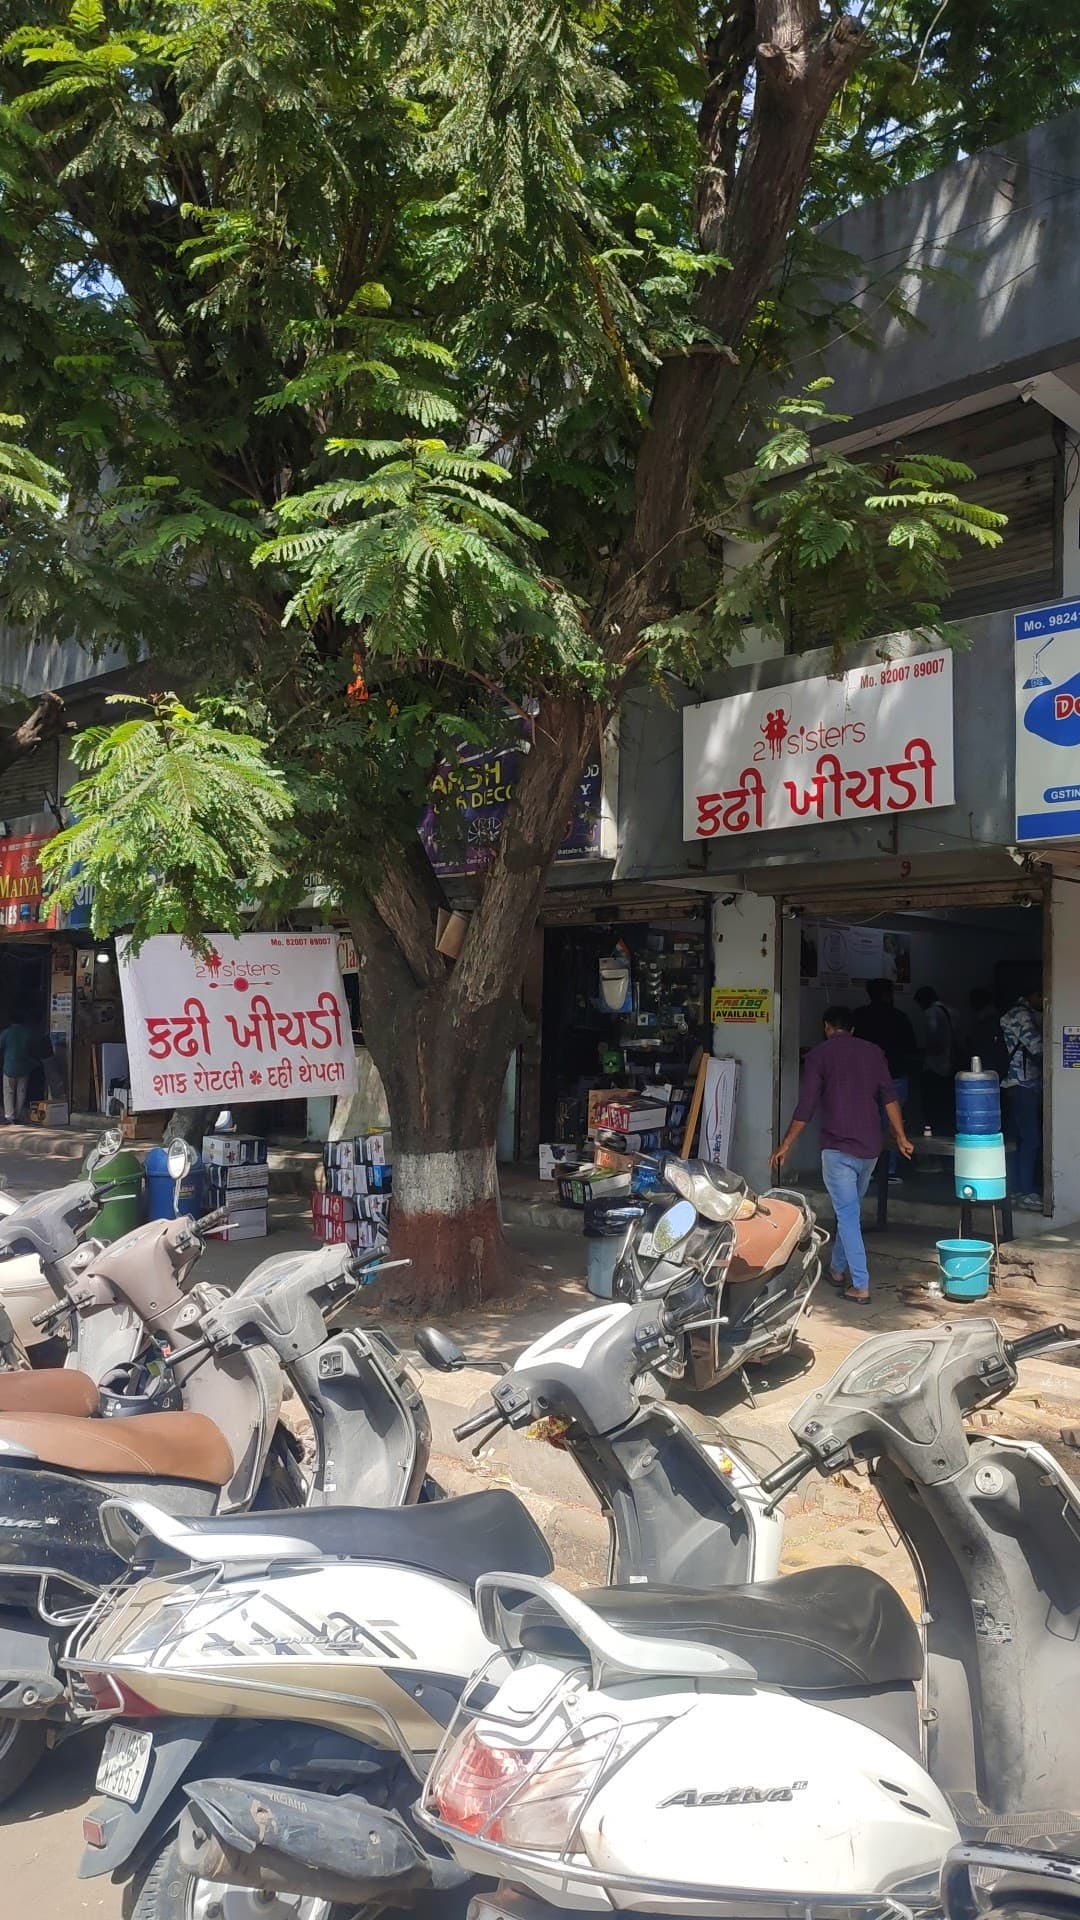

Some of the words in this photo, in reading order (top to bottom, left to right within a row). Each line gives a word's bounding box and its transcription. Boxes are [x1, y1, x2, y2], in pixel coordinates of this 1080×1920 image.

[1024, 620, 1046, 632] Mo.
[1049, 611, 1080, 627] 9824
[860, 675, 877, 688] Mo.
[880, 666, 910, 685] 82007
[913, 658, 945, 678] 89007
[753, 741, 766, 761] 2
[787, 720, 866, 754] sisters
[696, 767, 767, 837] કઢી
[784, 738, 937, 820] ખીચડી
[270, 938, 284, 946] Mo.
[286, 938, 307, 946] 82007
[309, 937, 331, 945] 89007
[195, 966, 207, 978] 2
[222, 960, 281, 977] sisters
[144, 997, 212, 1060] કઢી
[225, 991, 343, 1053] ખીચડી
[716, 1010, 767, 1018] AVAILABLE
[152, 1072, 188, 1097] શાક
[193, 1061, 244, 1092] રોટલી
[298, 1055, 346, 1084] થેપલા
[656, 1786, 793, 1809] Activa
